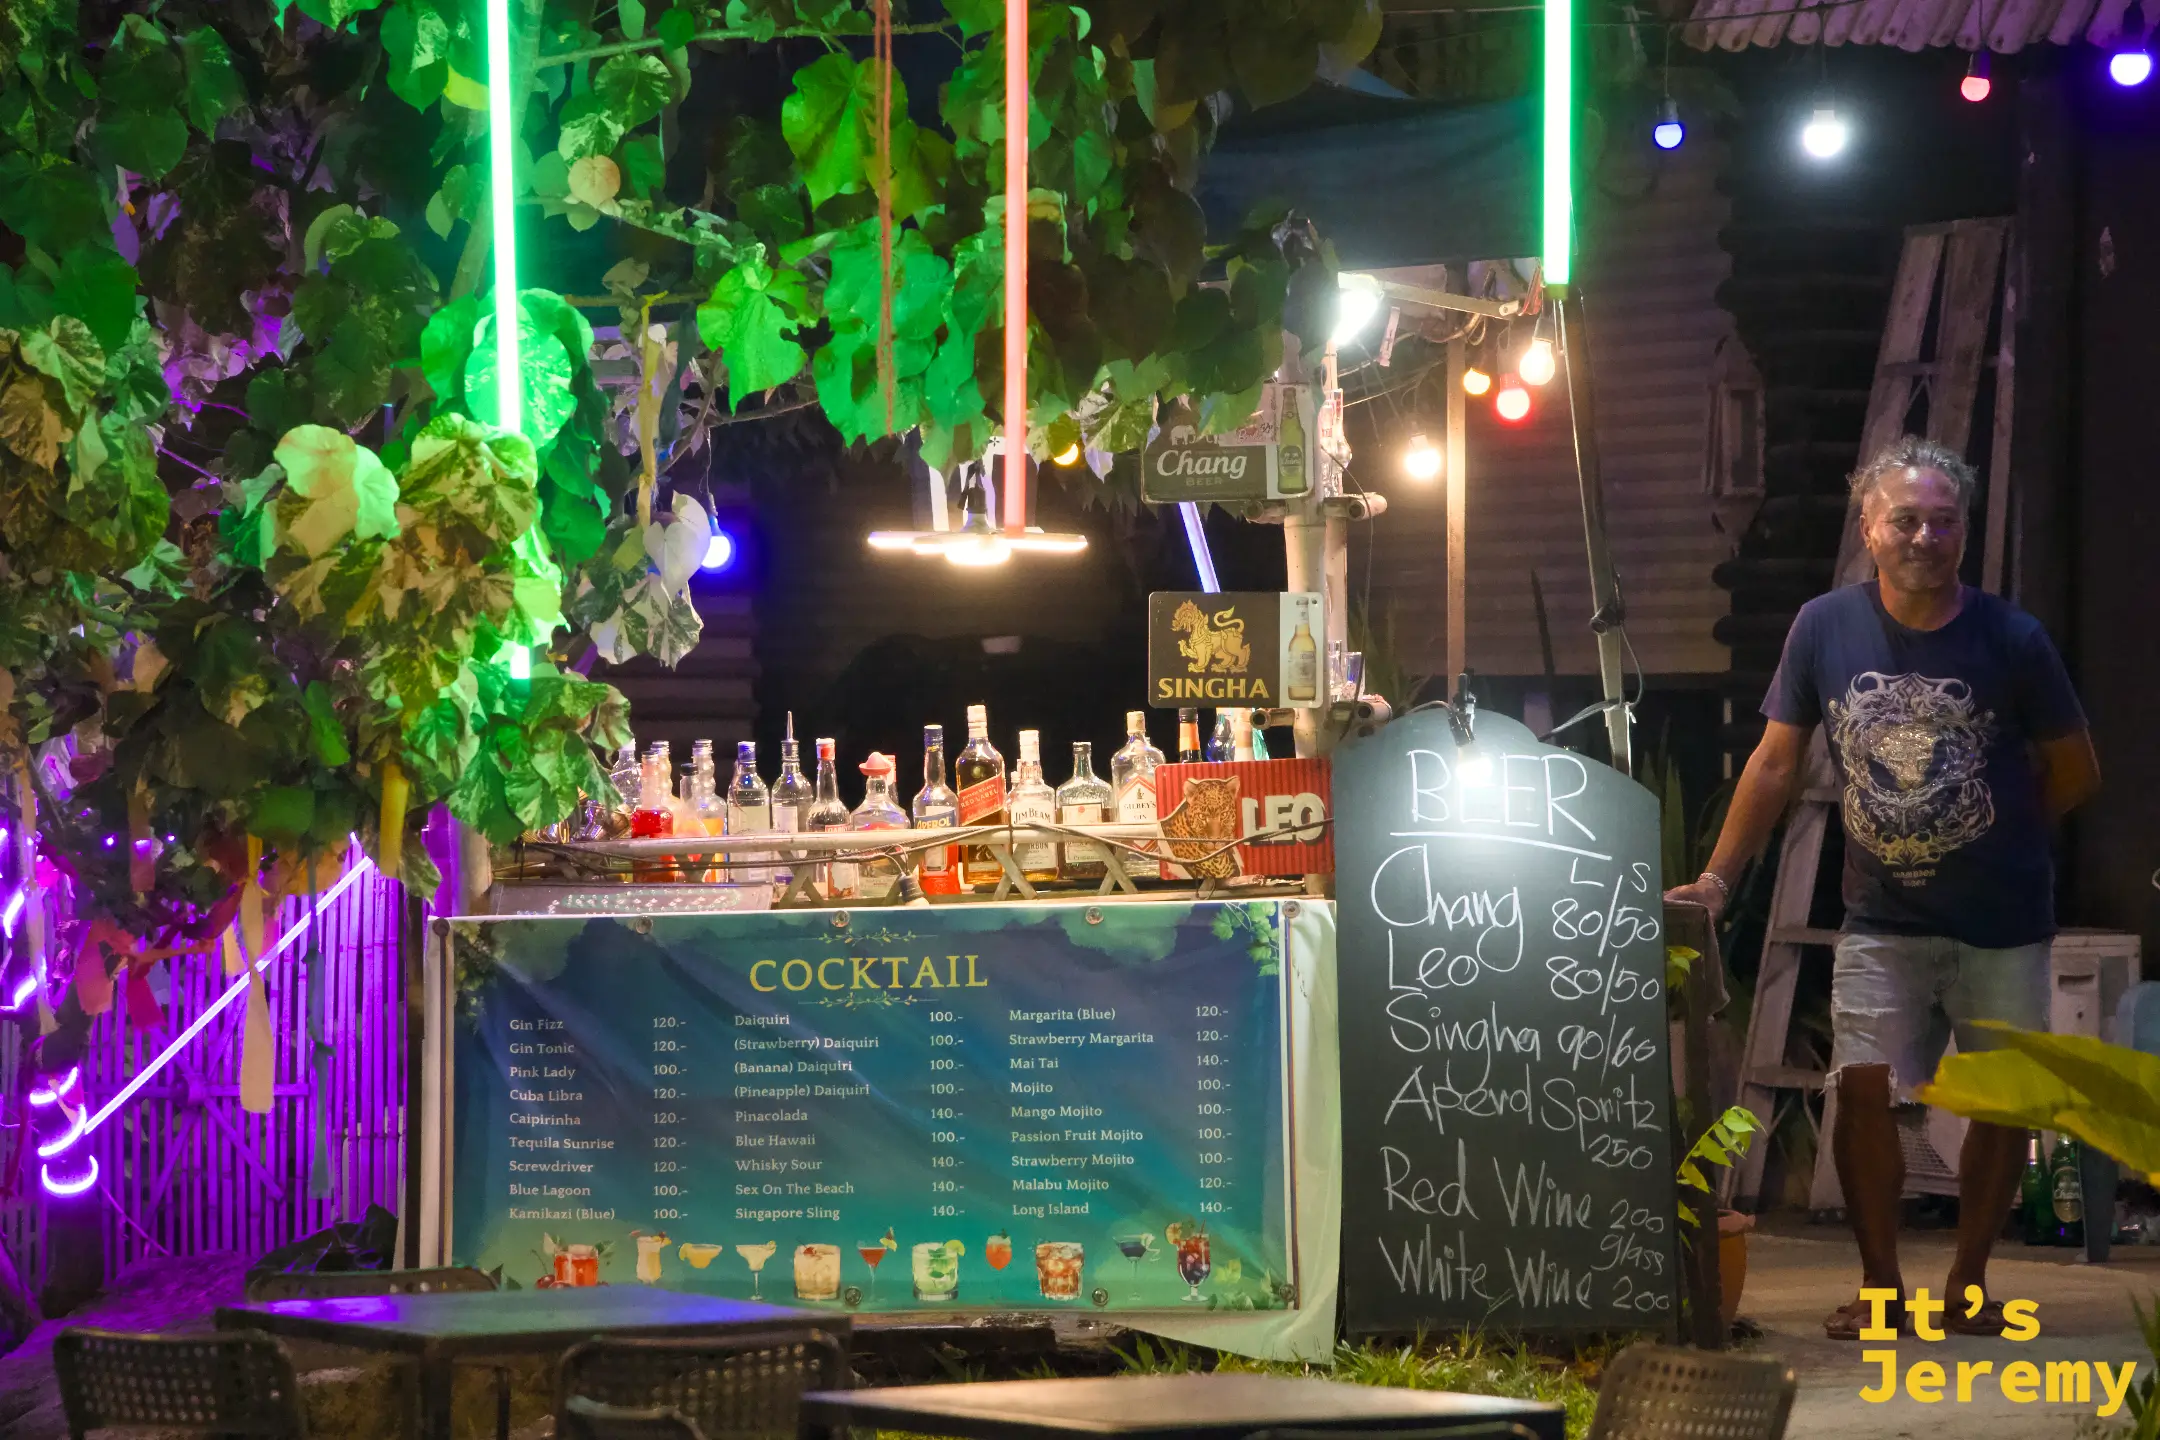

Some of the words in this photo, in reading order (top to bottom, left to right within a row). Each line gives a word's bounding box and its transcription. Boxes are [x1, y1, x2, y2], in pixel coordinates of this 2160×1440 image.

[1157, 449, 1248, 480] Chang
[1185, 477, 1223, 486] BEER
[1158, 677, 1270, 699] SINGHA
[1406, 748, 1597, 841] BEER
[1013, 811, 1028, 825] JIM
[1028, 807, 1051, 824] BEAM
[1241, 792, 1327, 847] LEO
[1371, 844, 1525, 972] Chang
[1551, 873, 1660, 957] 80/50
[749, 955, 989, 993] COCKTAIL
[1388, 929, 1480, 992] Leo
[1545, 952, 1660, 1016] 80/50
[735, 1015, 789, 1028] Daiquiri
[930, 1012, 962, 1021] 100.-
[1010, 1010, 1074, 1023] Margarita
[1078, 1008, 1115, 1020] (Blue)
[1196, 1006, 1228, 1016] 120.-
[510, 1020, 532, 1030] Gin
[538, 1020, 563, 1030] Fizz
[654, 1017, 686, 1028] 120.-
[735, 1037, 819, 1050] (Strawberry)
[824, 1037, 878, 1051] Daiquiri
[931, 1035, 963, 1045] 100.-
[1010, 1033, 1085, 1047] Strawberry
[1090, 1033, 1153, 1046] Margarita
[1197, 1030, 1228, 1041] 120.-
[1386, 992, 1541, 1091] Singha
[510, 1043, 533, 1053] Gin
[537, 1043, 574, 1054] Tonic
[654, 1041, 686, 1051] 120.-
[735, 1062, 792, 1074] (Banana)
[798, 1060, 853, 1074] Daiquiri
[931, 1060, 963, 1070] 100.-
[1010, 1058, 1034, 1068] Mai
[1039, 1058, 1058, 1068] Tai
[1197, 1055, 1228, 1065] 140.-
[510, 1066, 539, 1077] Pink
[544, 1066, 575, 1080] Lady
[654, 1065, 686, 1074] 100.-
[510, 1090, 543, 1101] Cuba
[549, 1090, 582, 1101] Libra
[654, 1088, 686, 1098] 120.-
[735, 1085, 810, 1099] (Pineapple)
[815, 1084, 869, 1098] Daiquiri
[931, 1083, 964, 1094] 100.-
[1011, 1082, 1053, 1096] Mojito
[1198, 1079, 1230, 1090] 100.-
[510, 1113, 580, 1127] Caipirinha
[654, 1113, 686, 1123] 120.-
[736, 1109, 807, 1121] Pinacolada
[931, 1108, 963, 1118] 140.-
[1012, 1107, 1055, 1120] Mango
[1060, 1106, 1102, 1119] Mojito
[1198, 1104, 1231, 1114] 100.-
[1541, 1074, 1663, 1153] Spritz
[736, 1135, 764, 1146] Blue
[769, 1134, 815, 1146] Hawaii
[932, 1132, 965, 1142] 100.-
[1012, 1131, 1060, 1142] Passion
[1065, 1130, 1096, 1140] Fruit
[1101, 1130, 1143, 1143] Mojito
[1199, 1128, 1231, 1139] 100.-
[509, 1137, 559, 1151] Tequila
[564, 1139, 614, 1149] Sunrise
[654, 1137, 686, 1148] 120.-
[1588, 1133, 1653, 1170] 250
[510, 1161, 593, 1172] Screwdriver
[654, 1162, 686, 1172] 120.-
[735, 1159, 787, 1173] Whisky
[791, 1159, 822, 1169] Sour
[932, 1156, 964, 1167] 140.-
[1012, 1154, 1087, 1168] Strawberry
[1092, 1154, 1134, 1167] Mojito
[1200, 1153, 1232, 1164] 100.-
[510, 1184, 539, 1195] Blue
[543, 1185, 590, 1198] Lagoon
[654, 1186, 687, 1195] 100.-
[736, 1184, 758, 1195] Sex
[763, 1184, 781, 1194] On
[786, 1183, 810, 1194] The
[816, 1182, 854, 1193] Beach
[933, 1181, 964, 1191] 140.-
[1013, 1179, 1061, 1190] Malabu
[1066, 1179, 1109, 1193] Mojito
[1200, 1177, 1232, 1188] 120.-
[1380, 1137, 1480, 1220] Red
[1493, 1156, 1592, 1230] Wine
[1609, 1198, 1665, 1234] 200
[510, 1208, 571, 1219] Kamikazi
[577, 1208, 614, 1220] (Blue)
[654, 1209, 688, 1218] 100.-
[736, 1208, 803, 1221] Singapore
[807, 1207, 840, 1221] Sling
[932, 1206, 964, 1216] 140.-
[1013, 1205, 1044, 1218] Long
[1049, 1202, 1089, 1214] Island
[1200, 1202, 1232, 1212] 140.-
[1378, 1223, 1496, 1301] White
[1504, 1246, 1593, 1311] Wine
[1612, 1276, 1670, 1312] 200
